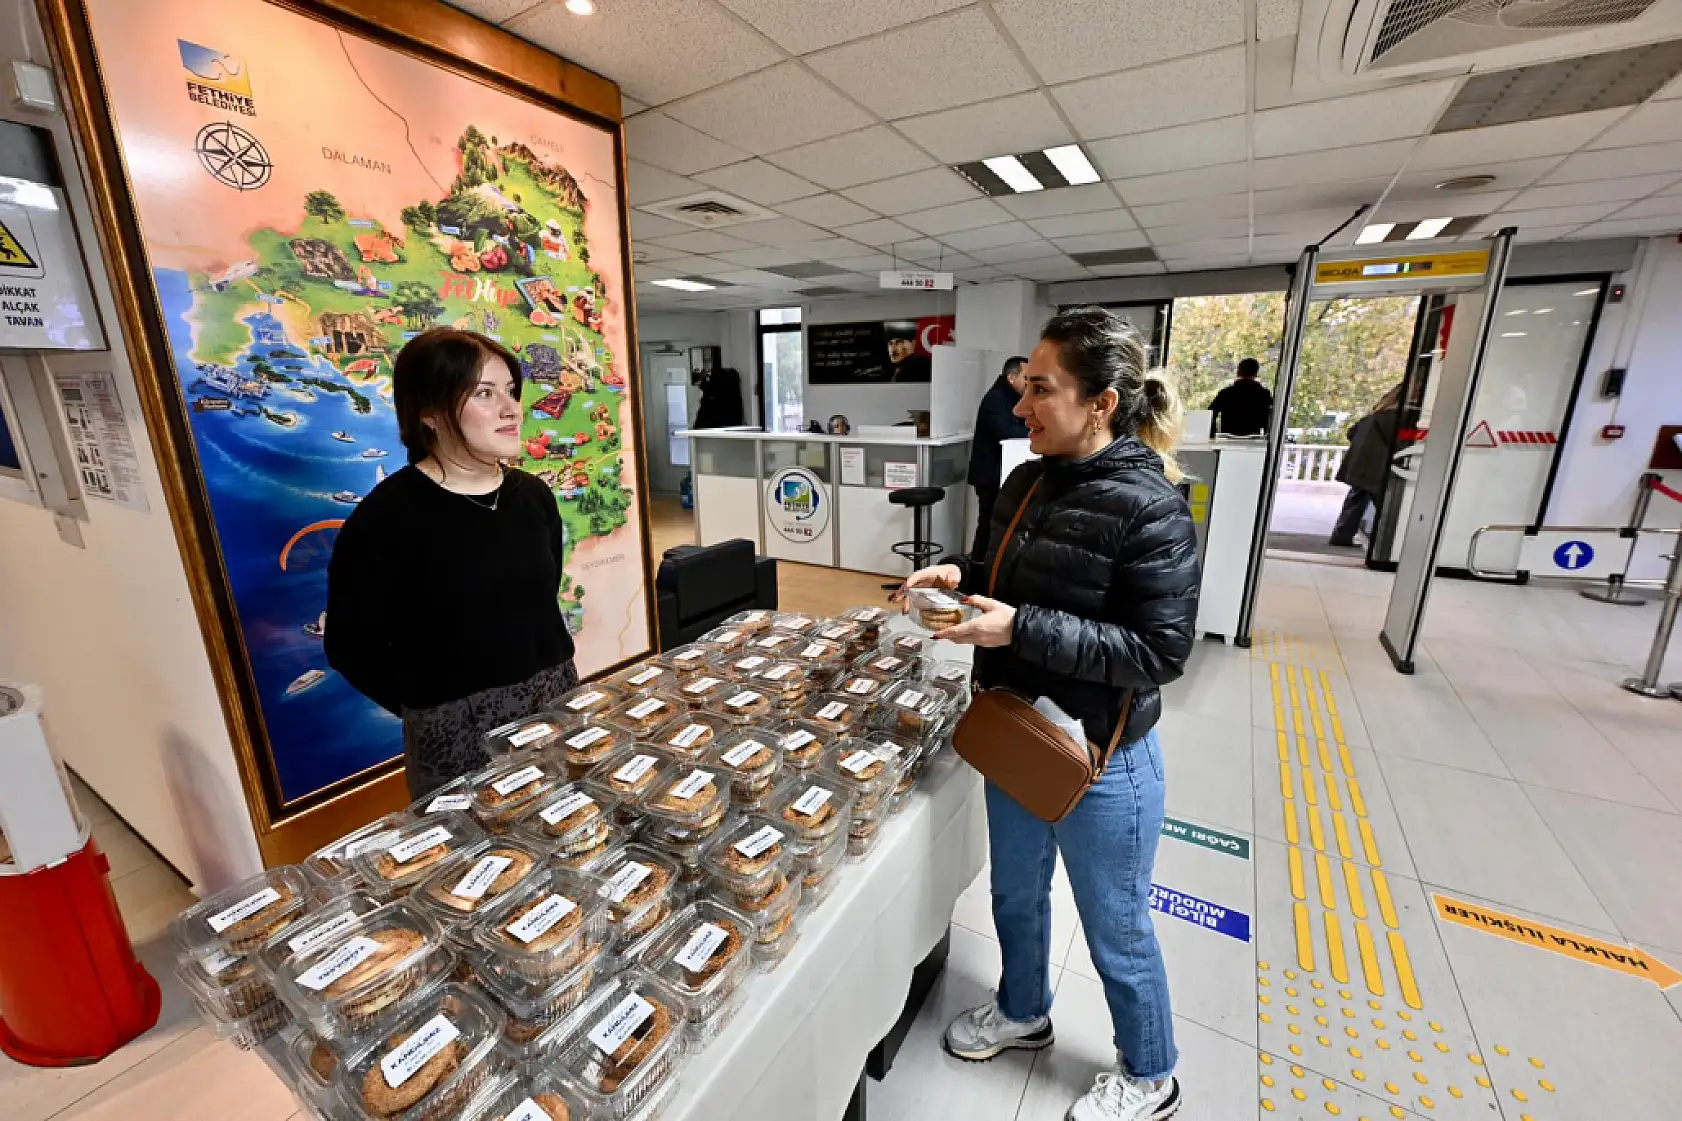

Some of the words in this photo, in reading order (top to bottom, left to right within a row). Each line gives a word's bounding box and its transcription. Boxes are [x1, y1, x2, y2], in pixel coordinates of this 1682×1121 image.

[321, 146, 392, 175] DALAMAN
[5, 315, 44, 328] TAVAN
[1162, 822, 1187, 836] ME
[1148, 887, 1226, 919] MÜDÜRL
[1549, 934, 1649, 972] HALKLA
